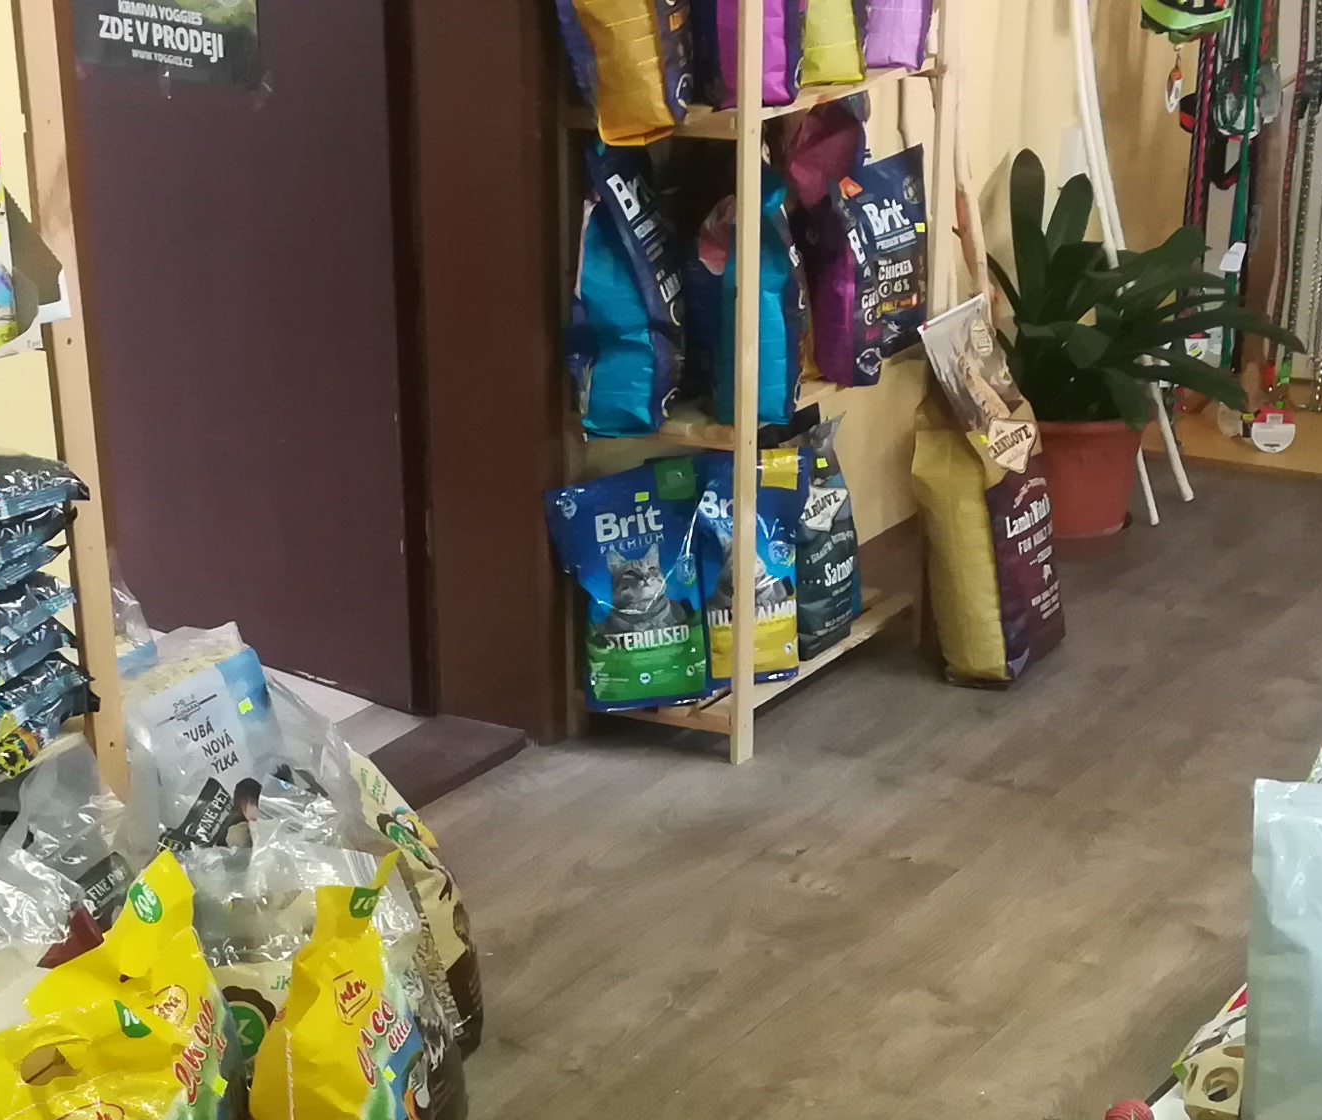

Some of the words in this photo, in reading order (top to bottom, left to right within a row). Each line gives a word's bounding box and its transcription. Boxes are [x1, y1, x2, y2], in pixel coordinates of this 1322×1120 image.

[98, 14, 135, 43] ZDE
[135, 20, 150, 45] V
[151, 24, 224, 63] PRODEJI
[862, 198, 910, 237] Brit
[595, 505, 664, 543] Brit
[600, 533, 665, 554] PREMIUM
[605, 624, 689, 651] STERILISED
